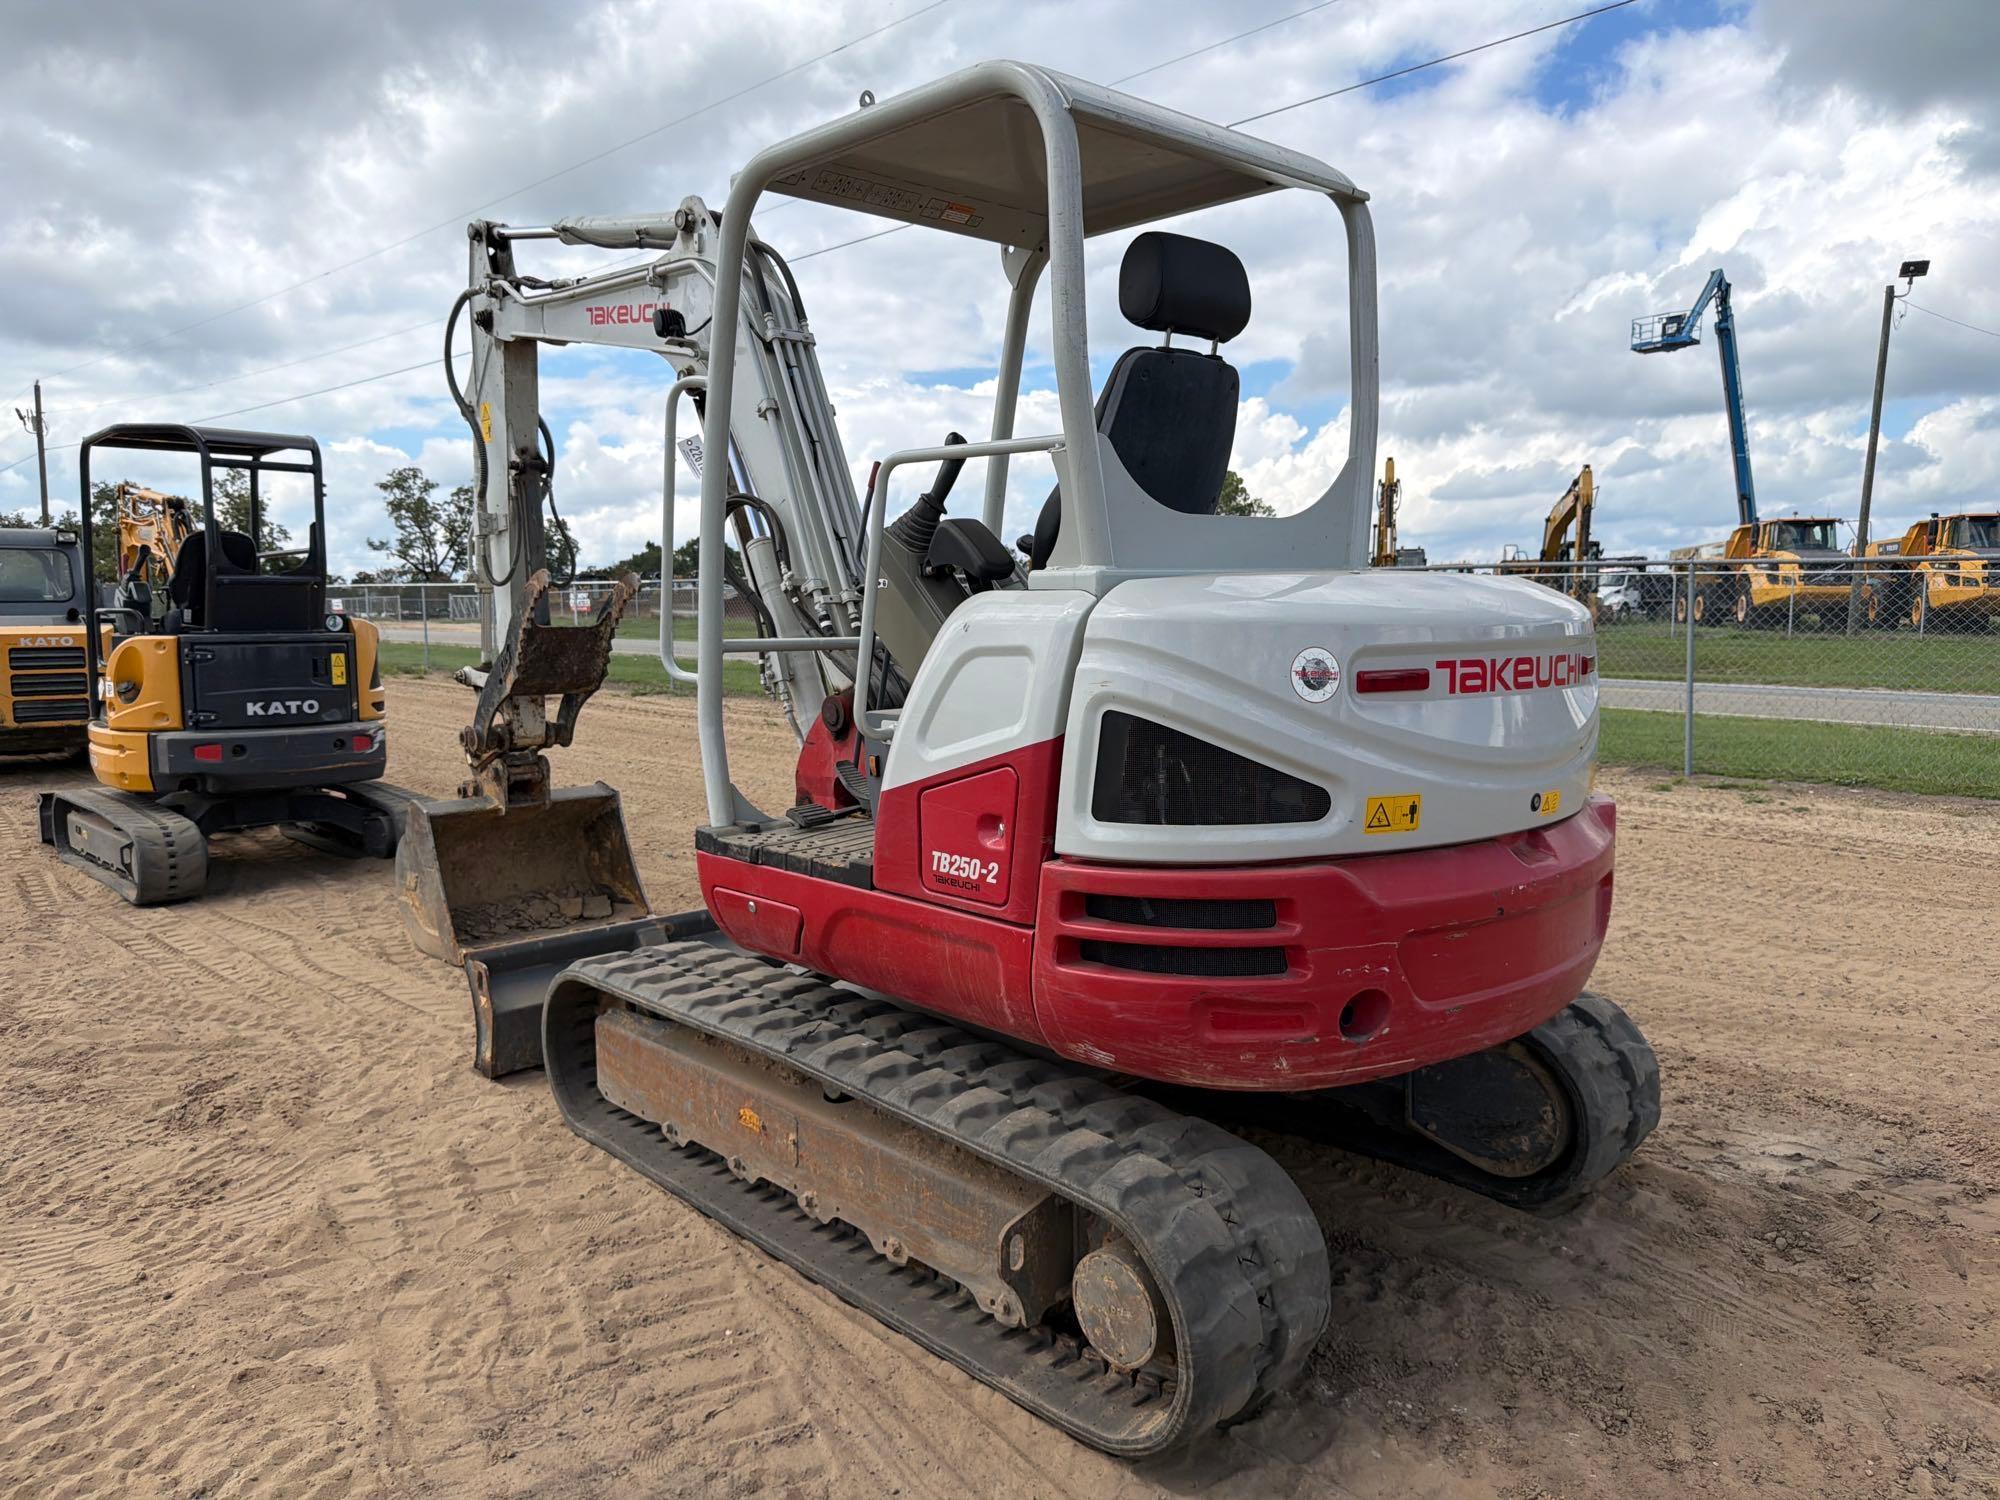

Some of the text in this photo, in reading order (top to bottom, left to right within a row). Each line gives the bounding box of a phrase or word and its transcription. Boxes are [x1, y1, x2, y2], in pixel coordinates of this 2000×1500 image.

[585, 302, 670, 325] TAKEUC
[19, 636, 74, 647] KATO
[1435, 653, 1581, 694] TAKEUCHI
[246, 699, 319, 716] KATO
[931, 850, 999, 884] TB250-2
[933, 874, 980, 892] TAKEUCHI
